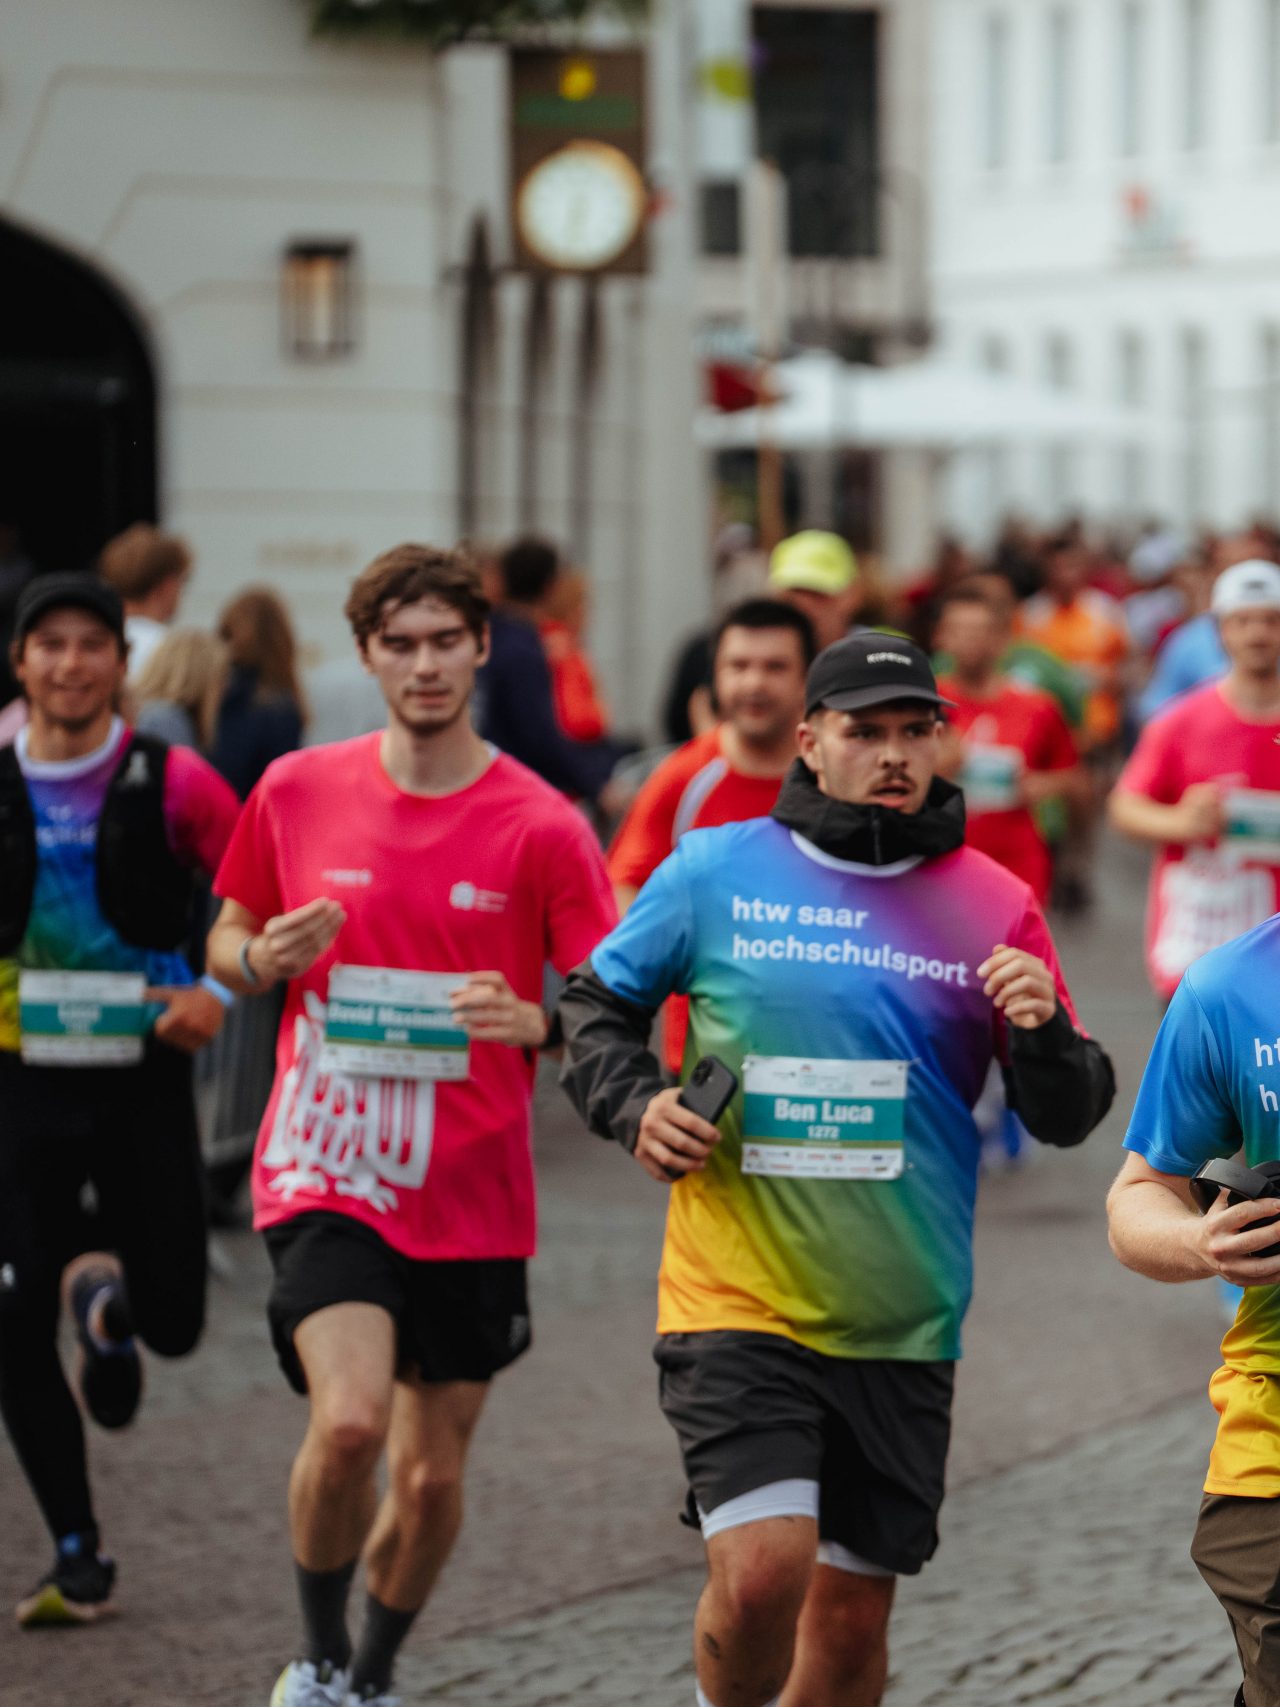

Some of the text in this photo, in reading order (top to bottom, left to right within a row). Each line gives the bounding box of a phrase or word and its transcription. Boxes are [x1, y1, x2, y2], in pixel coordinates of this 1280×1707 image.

[732, 895, 869, 929] htw saar
[732, 934, 969, 987] hochschulsport
[774, 1098, 875, 1124] Ben Luca
[807, 1125, 840, 1139] 1272
